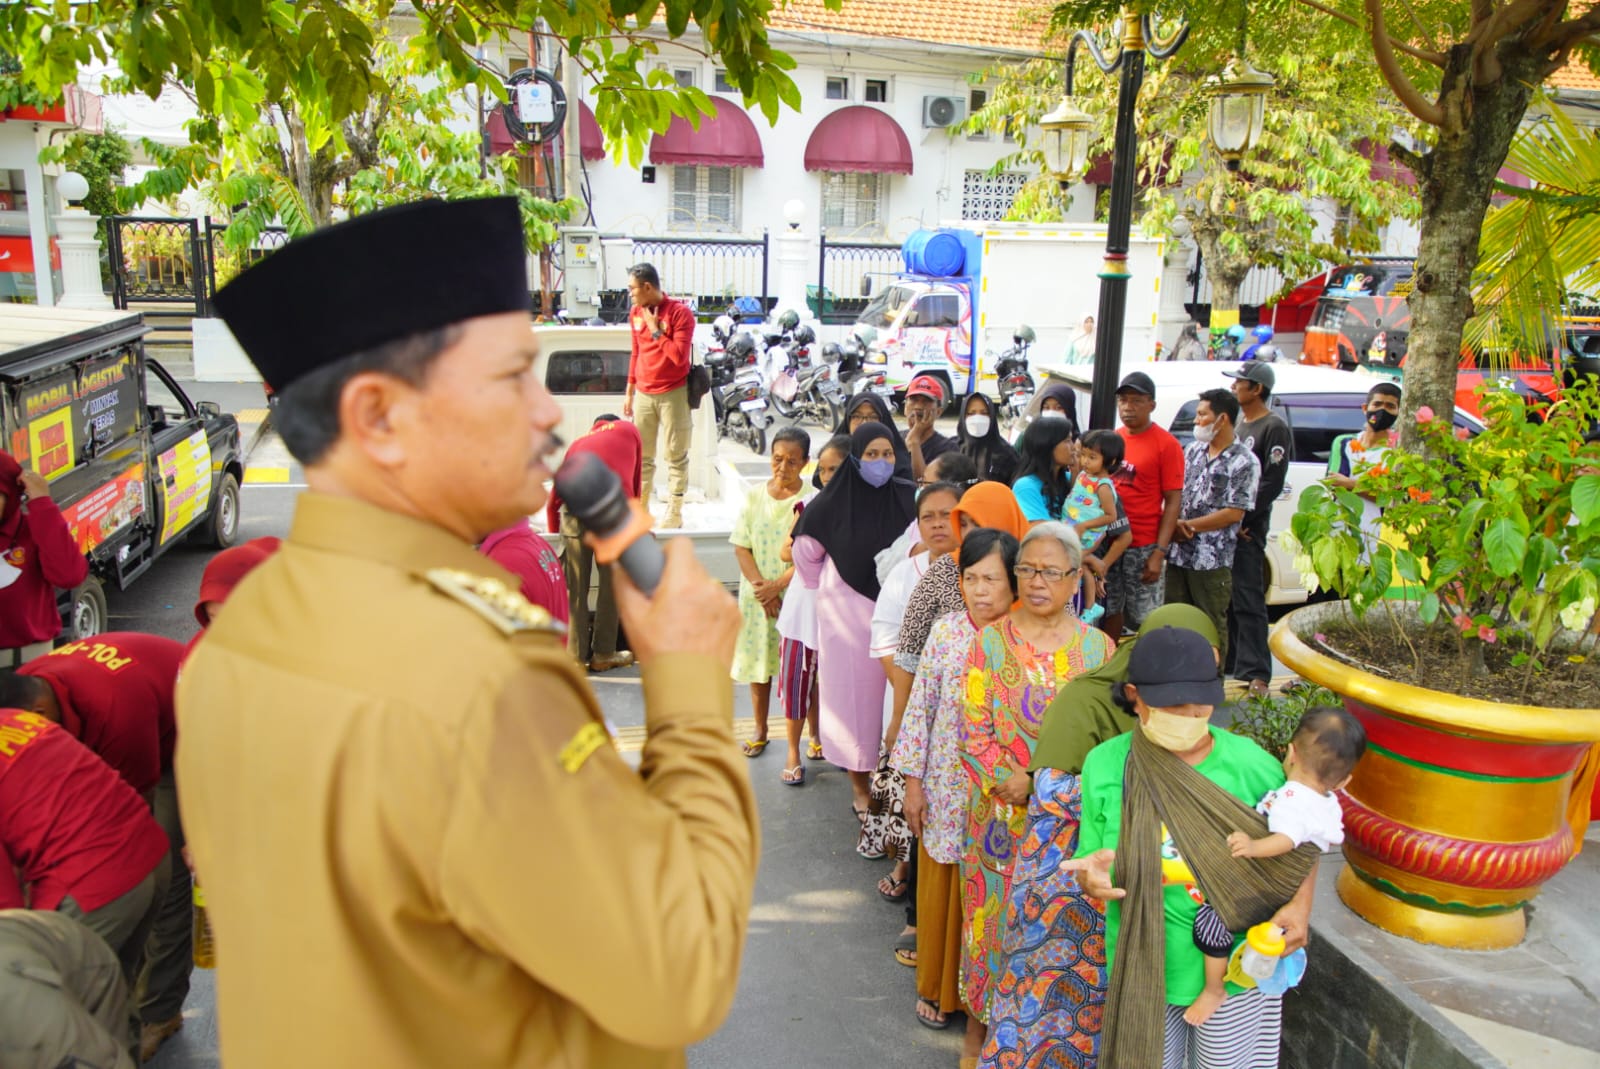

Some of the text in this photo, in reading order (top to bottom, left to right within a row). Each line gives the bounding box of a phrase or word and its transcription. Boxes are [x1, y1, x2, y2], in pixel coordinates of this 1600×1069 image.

[26, 363, 125, 418] MOBIL LOGISTIK
[89, 389, 119, 414] MINYAK
